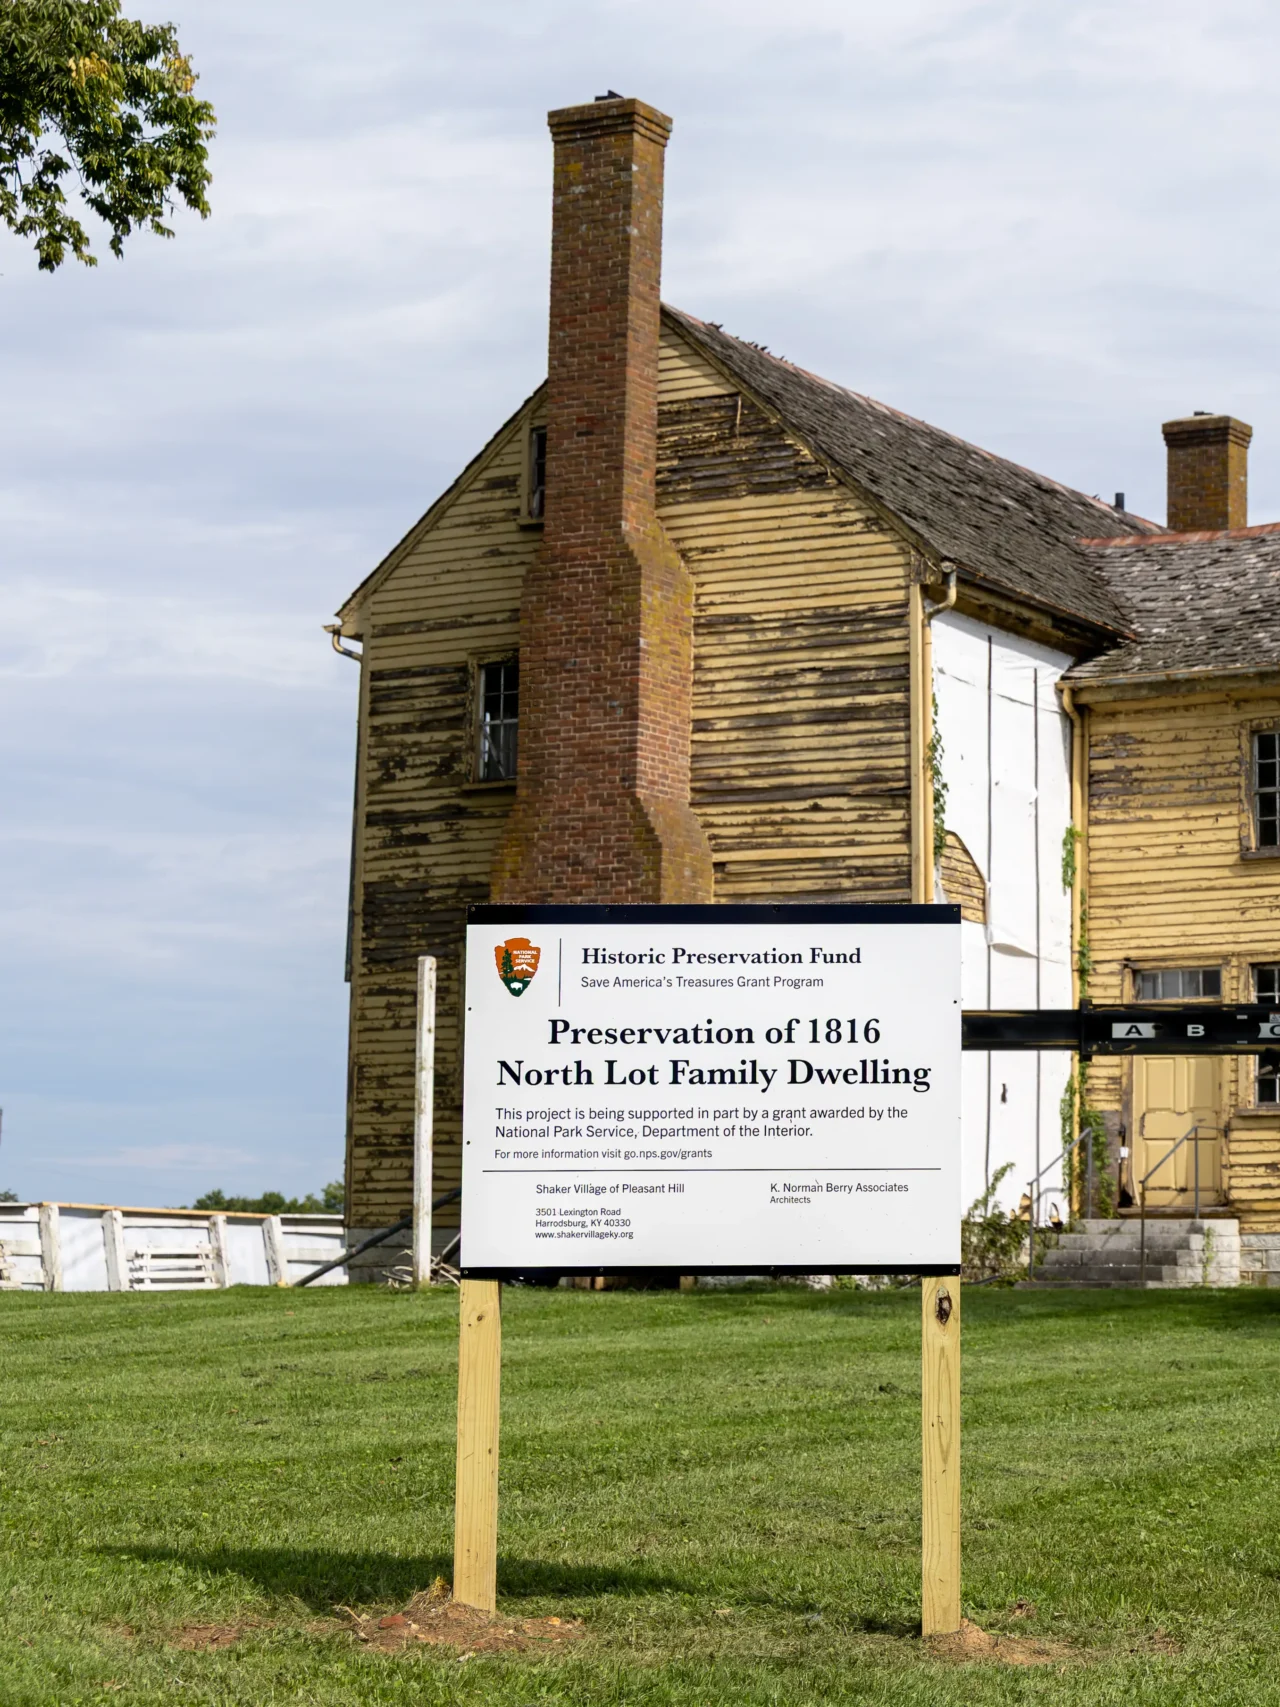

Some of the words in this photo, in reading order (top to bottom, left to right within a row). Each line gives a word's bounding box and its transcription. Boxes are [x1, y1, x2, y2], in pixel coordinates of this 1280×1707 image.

[582, 948, 665, 964] Historic
[672, 947, 803, 964] Preservation
[809, 947, 861, 964] Fund
[581, 976, 609, 987] Save
[613, 976, 672, 987] America's
[676, 976, 734, 987] Treasures
[737, 976, 770, 987] Grant
[774, 976, 824, 990] Program
[548, 1018, 755, 1045] Preservation
[765, 1018, 800, 1044] of
[809, 1018, 880, 1044] 1816
[1125, 1025, 1143, 1036] A
[1187, 1025, 1205, 1037] B
[496, 1060, 594, 1086] North
[604, 1060, 659, 1085] Lot
[668, 1059, 778, 1093] Family
[787, 1059, 932, 1093] Dwelling
[496, 1108, 522, 1120] This
[526, 1108, 571, 1122] project
[575, 1108, 585, 1119] is
[589, 1107, 624, 1122] being
[628, 1107, 693, 1121] supported
[698, 1107, 709, 1119] in
[713, 1108, 739, 1121] part
[743, 1107, 758, 1121] by
[761, 1110, 769, 1119] a
[772, 1107, 806, 1121] grant
[810, 1107, 864, 1118] awarded
[869, 1107, 884, 1121] by
[887, 1106, 908, 1118] the
[496, 1126, 549, 1138] National
[554, 1126, 582, 1137] Park
[586, 1125, 637, 1139] Service,
[643, 1125, 719, 1139] Department
[723, 1125, 736, 1137] of
[739, 1125, 760, 1137] the
[764, 1124, 812, 1137] Interior.
[495, 1149, 510, 1159] For
[513, 1151, 539, 1159] more
[542, 1149, 599, 1158] information
[602, 1149, 621, 1158] visit
[624, 1149, 712, 1160] go.nps.gov/grants
[536, 1184, 571, 1194] Shaker
[574, 1184, 607, 1195] Village
[610, 1184, 619, 1193] of
[622, 1184, 665, 1193] Pleasant
[668, 1184, 684, 1193] Hill
[770, 1183, 781, 1193] K.
[783, 1183, 823, 1193] Norman
[826, 1183, 853, 1193] Berry
[856, 1183, 908, 1192] Associates
[770, 1196, 811, 1204] Architects
[536, 1208, 556, 1216] 3501
[536, 1220, 588, 1228] Harrodsburg,
[604, 1219, 631, 1227] 40330
[535, 1231, 633, 1239] www.shakervillageky.org
